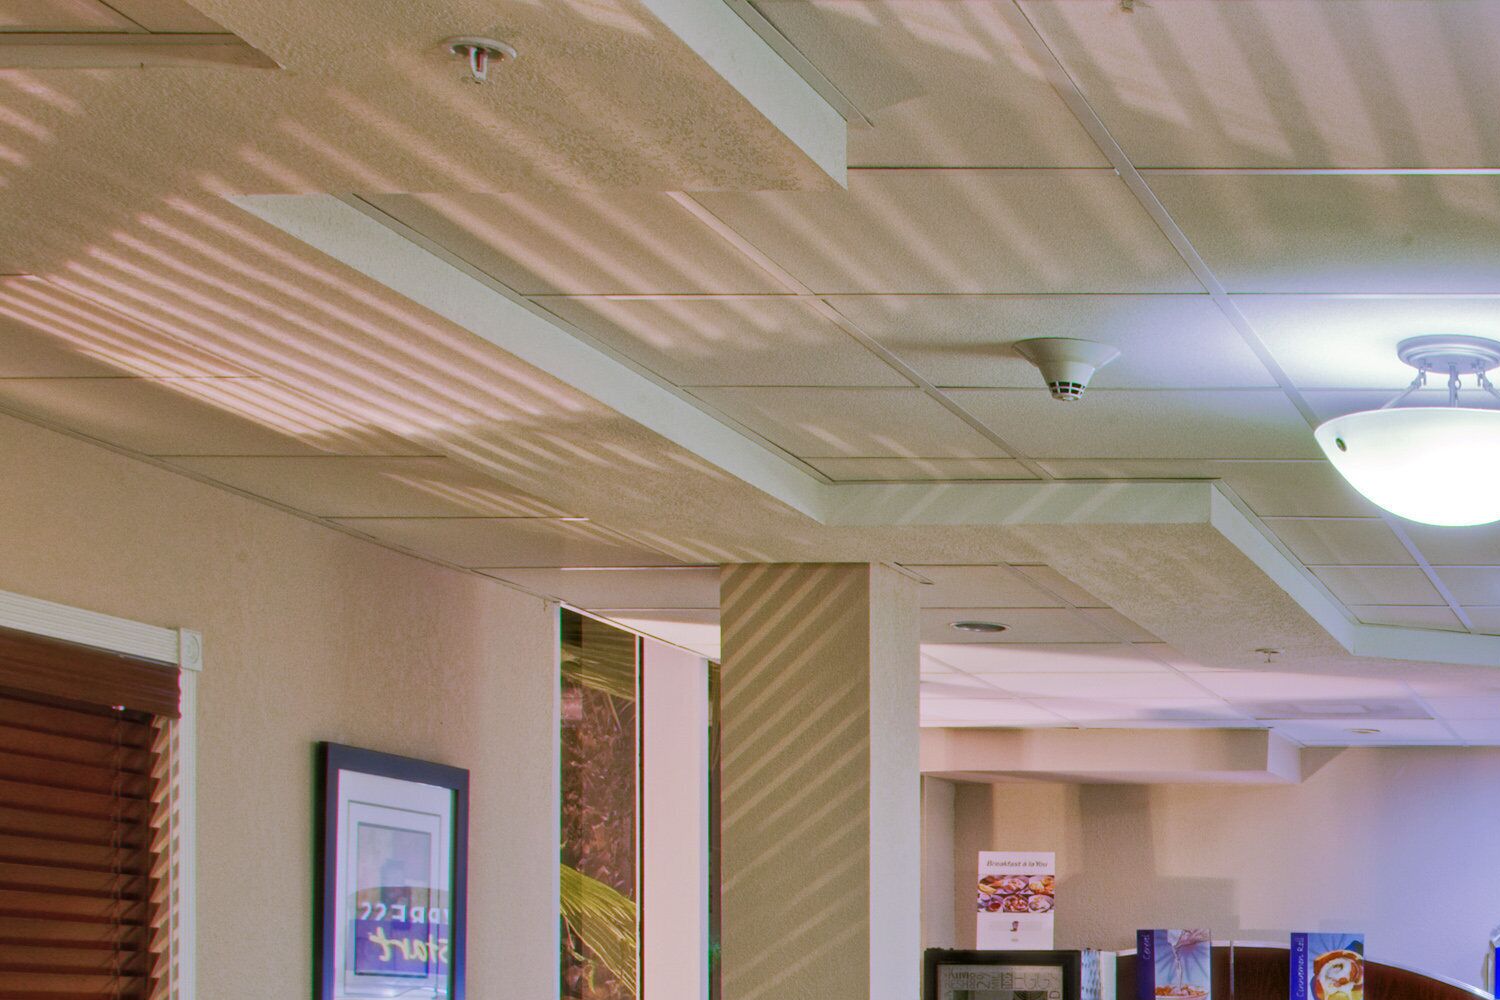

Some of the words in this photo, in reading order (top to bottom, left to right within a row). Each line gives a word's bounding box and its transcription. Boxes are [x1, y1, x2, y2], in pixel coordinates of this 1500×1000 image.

[1142, 934, 1151, 960] Cereal
[1296, 937, 1305, 952] Roll
[1296, 954, 1305, 998] Cinnamon
